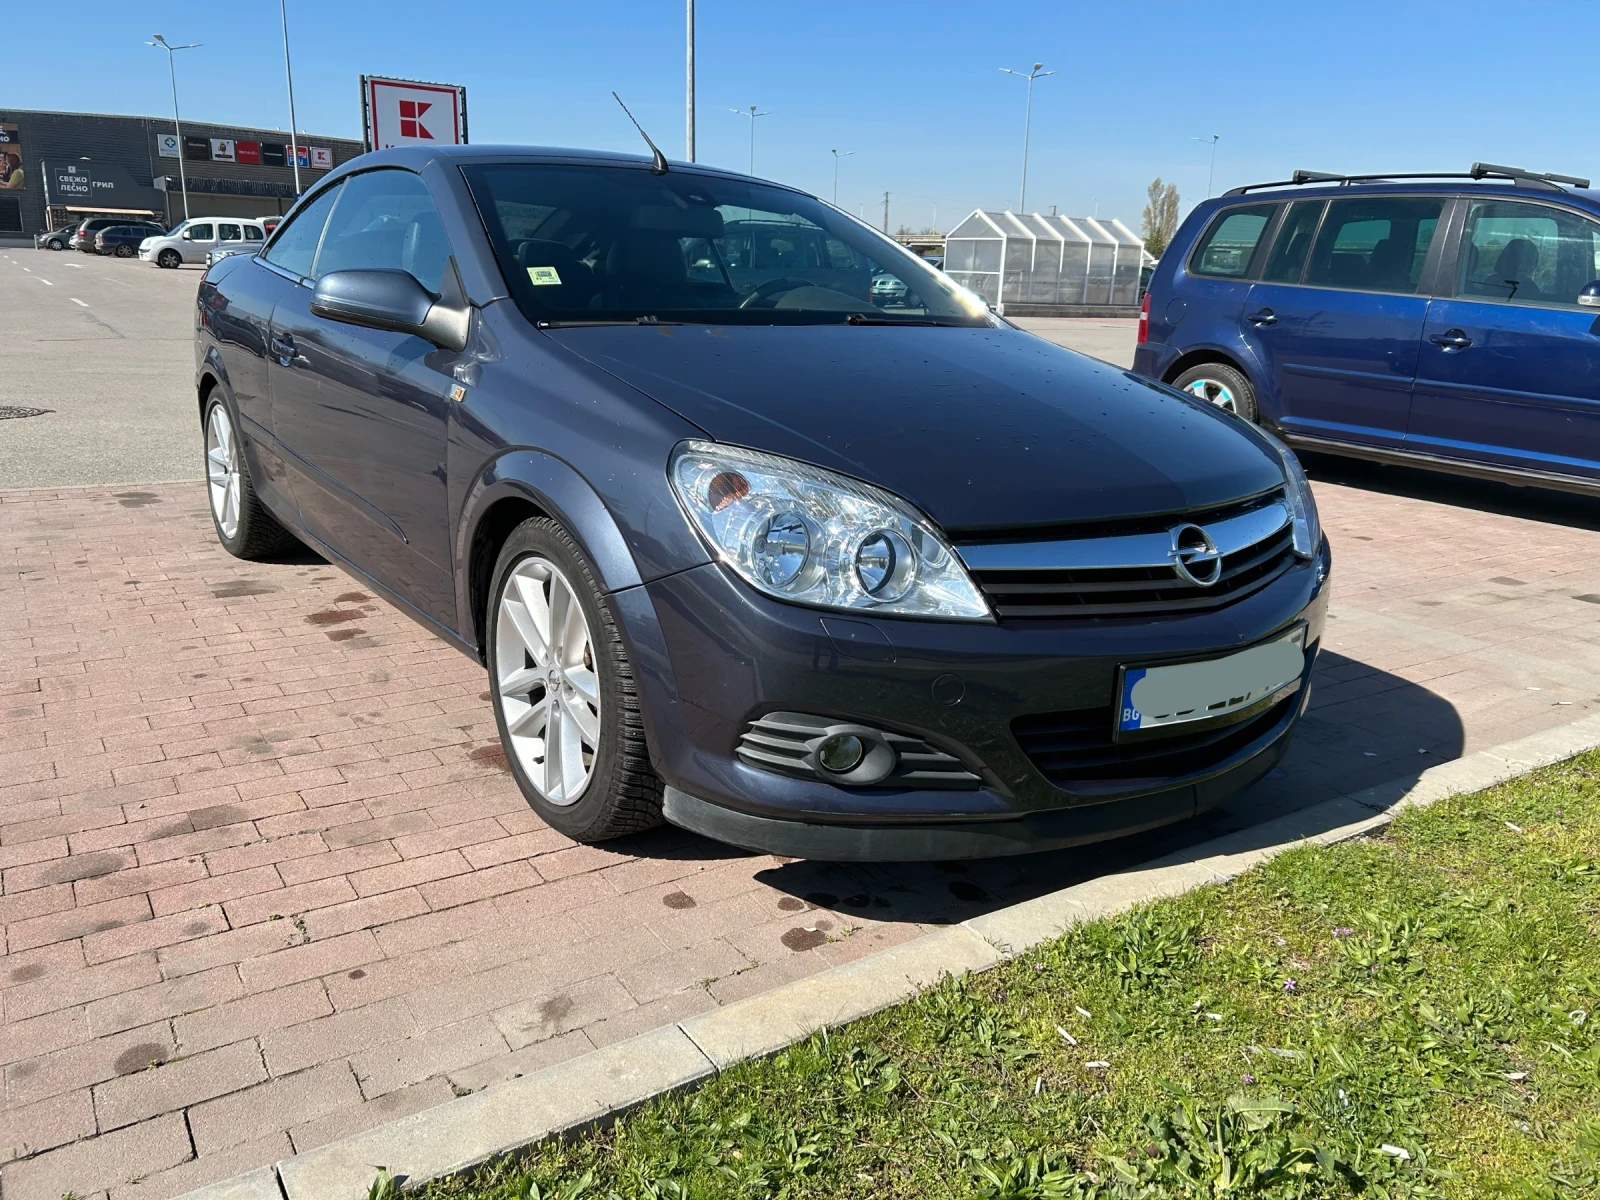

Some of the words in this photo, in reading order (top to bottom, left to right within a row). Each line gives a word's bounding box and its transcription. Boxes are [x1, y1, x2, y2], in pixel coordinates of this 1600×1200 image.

[288, 149, 307, 158] Esy
[289, 156, 304, 166] Py
[59, 175, 88, 183] СВЕЖО
[60, 184, 89, 192] ЛЕСНО
[92, 181, 114, 189] ГРИЛ
[1122, 708, 1139, 721] BG
